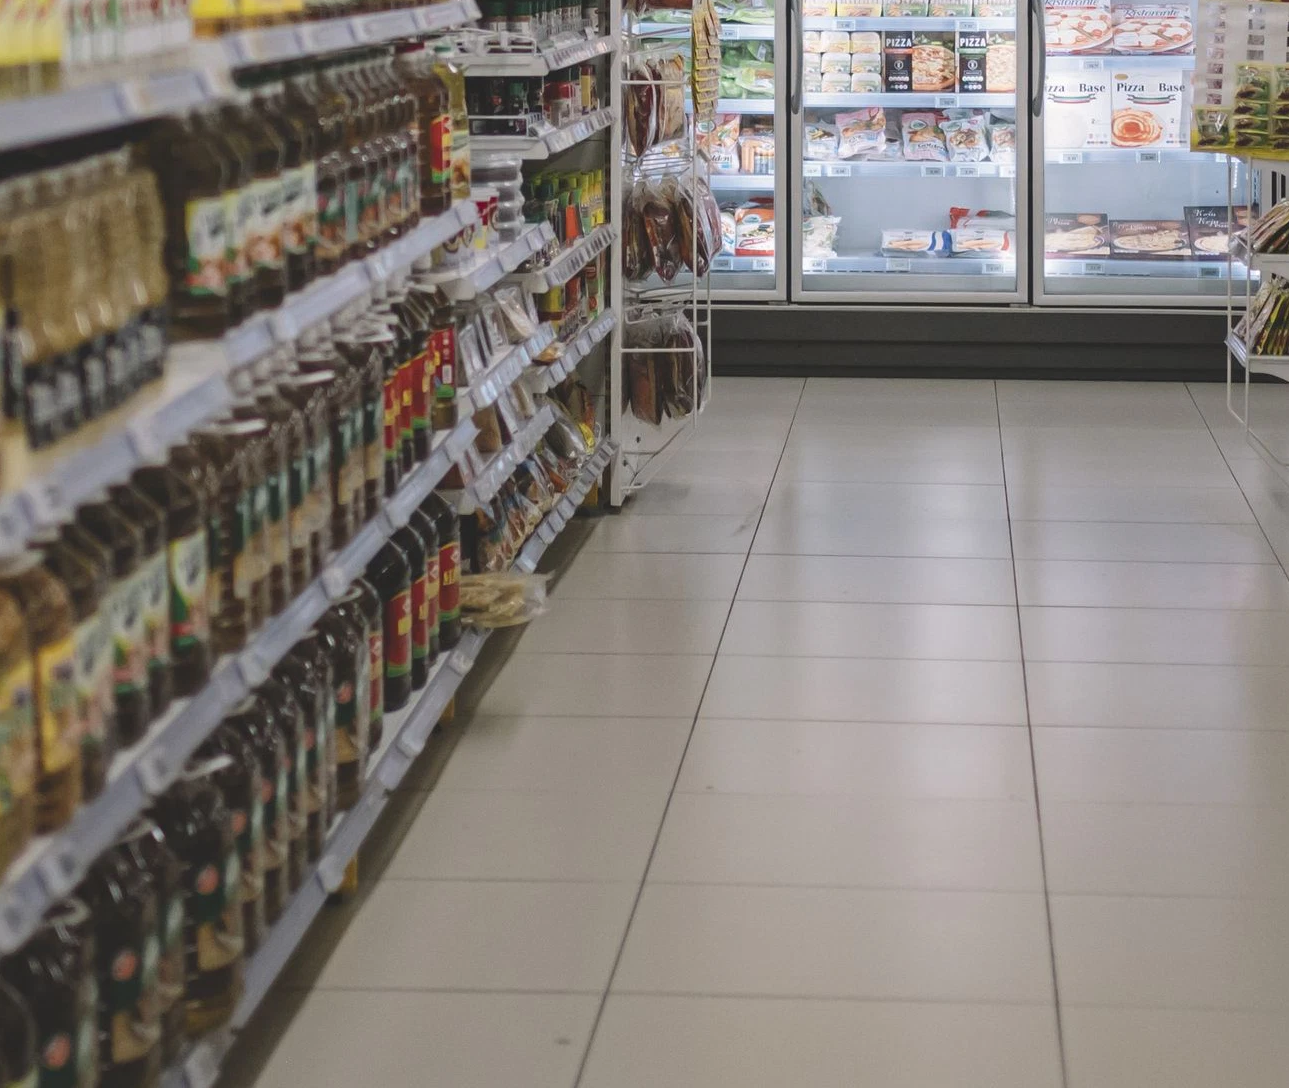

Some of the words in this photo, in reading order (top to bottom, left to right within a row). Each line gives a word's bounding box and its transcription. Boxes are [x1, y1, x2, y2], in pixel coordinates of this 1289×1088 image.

[1124, 7, 1179, 17] Ristorante
[885, 38, 912, 47] PIZZA
[960, 38, 986, 47] PIZZA
[1079, 83, 1106, 93] Base
[1116, 83, 1145, 92] Pizza
[1159, 83, 1186, 92] Base
